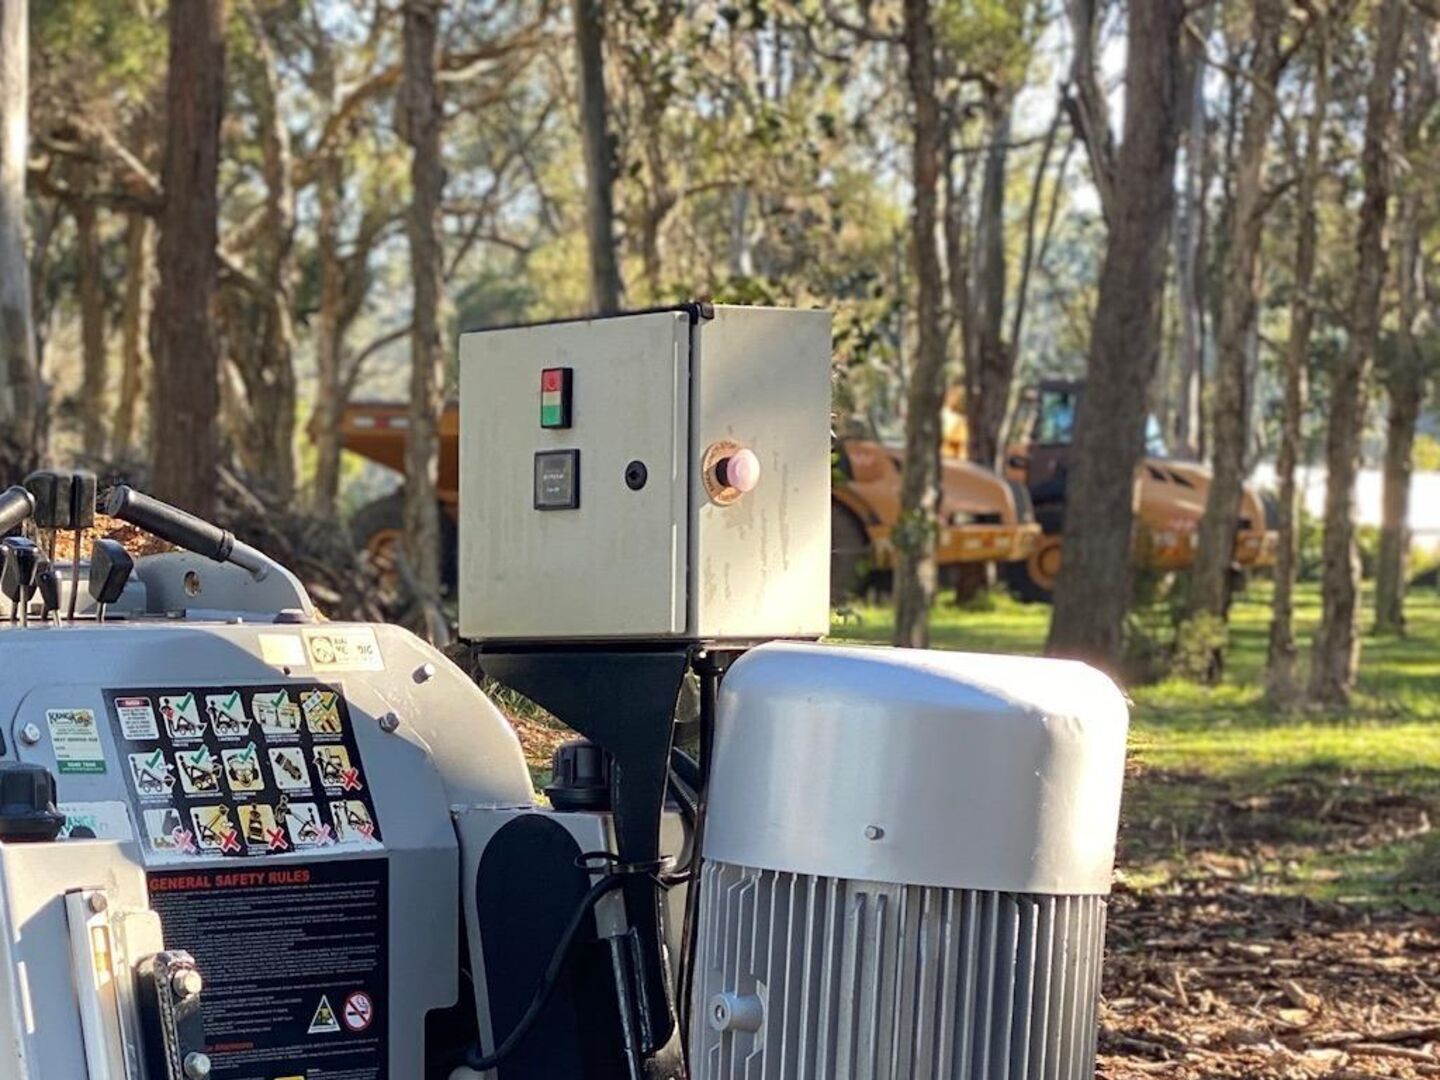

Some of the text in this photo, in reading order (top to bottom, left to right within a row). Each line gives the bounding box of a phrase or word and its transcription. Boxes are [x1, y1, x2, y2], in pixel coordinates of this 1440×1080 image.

[149, 869, 310, 891] GENERAL SAFETY RULES
